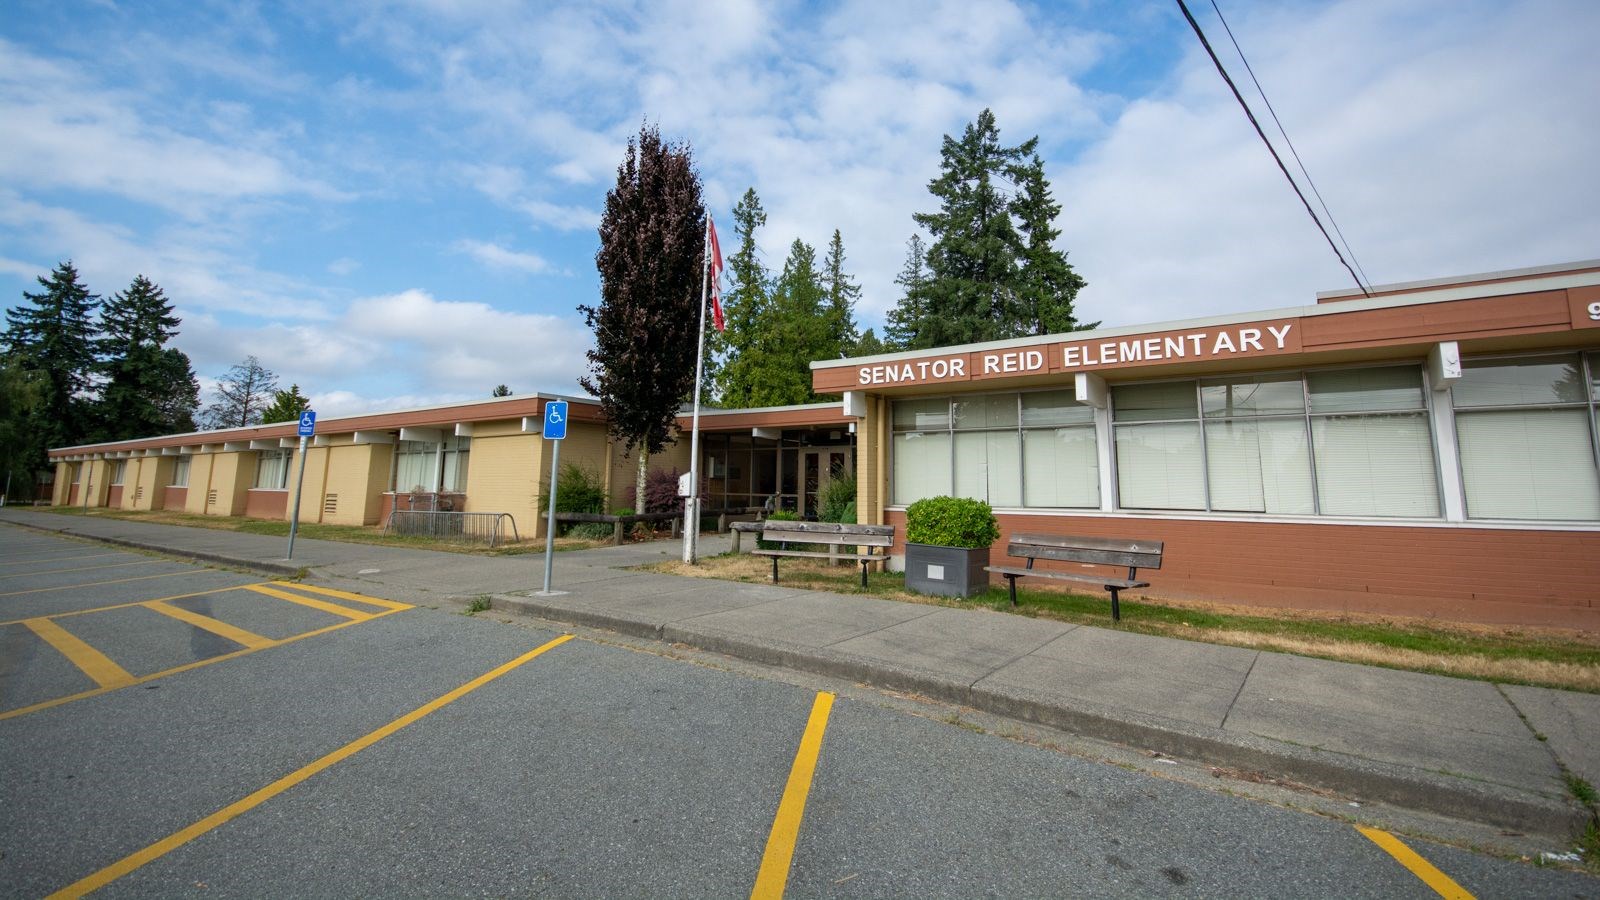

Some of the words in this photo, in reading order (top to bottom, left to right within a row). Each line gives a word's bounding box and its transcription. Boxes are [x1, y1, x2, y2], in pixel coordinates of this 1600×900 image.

[858, 358, 966, 385] SENATOR
[984, 350, 1043, 374] REID
[1063, 325, 1292, 367] ELEMENTARY
